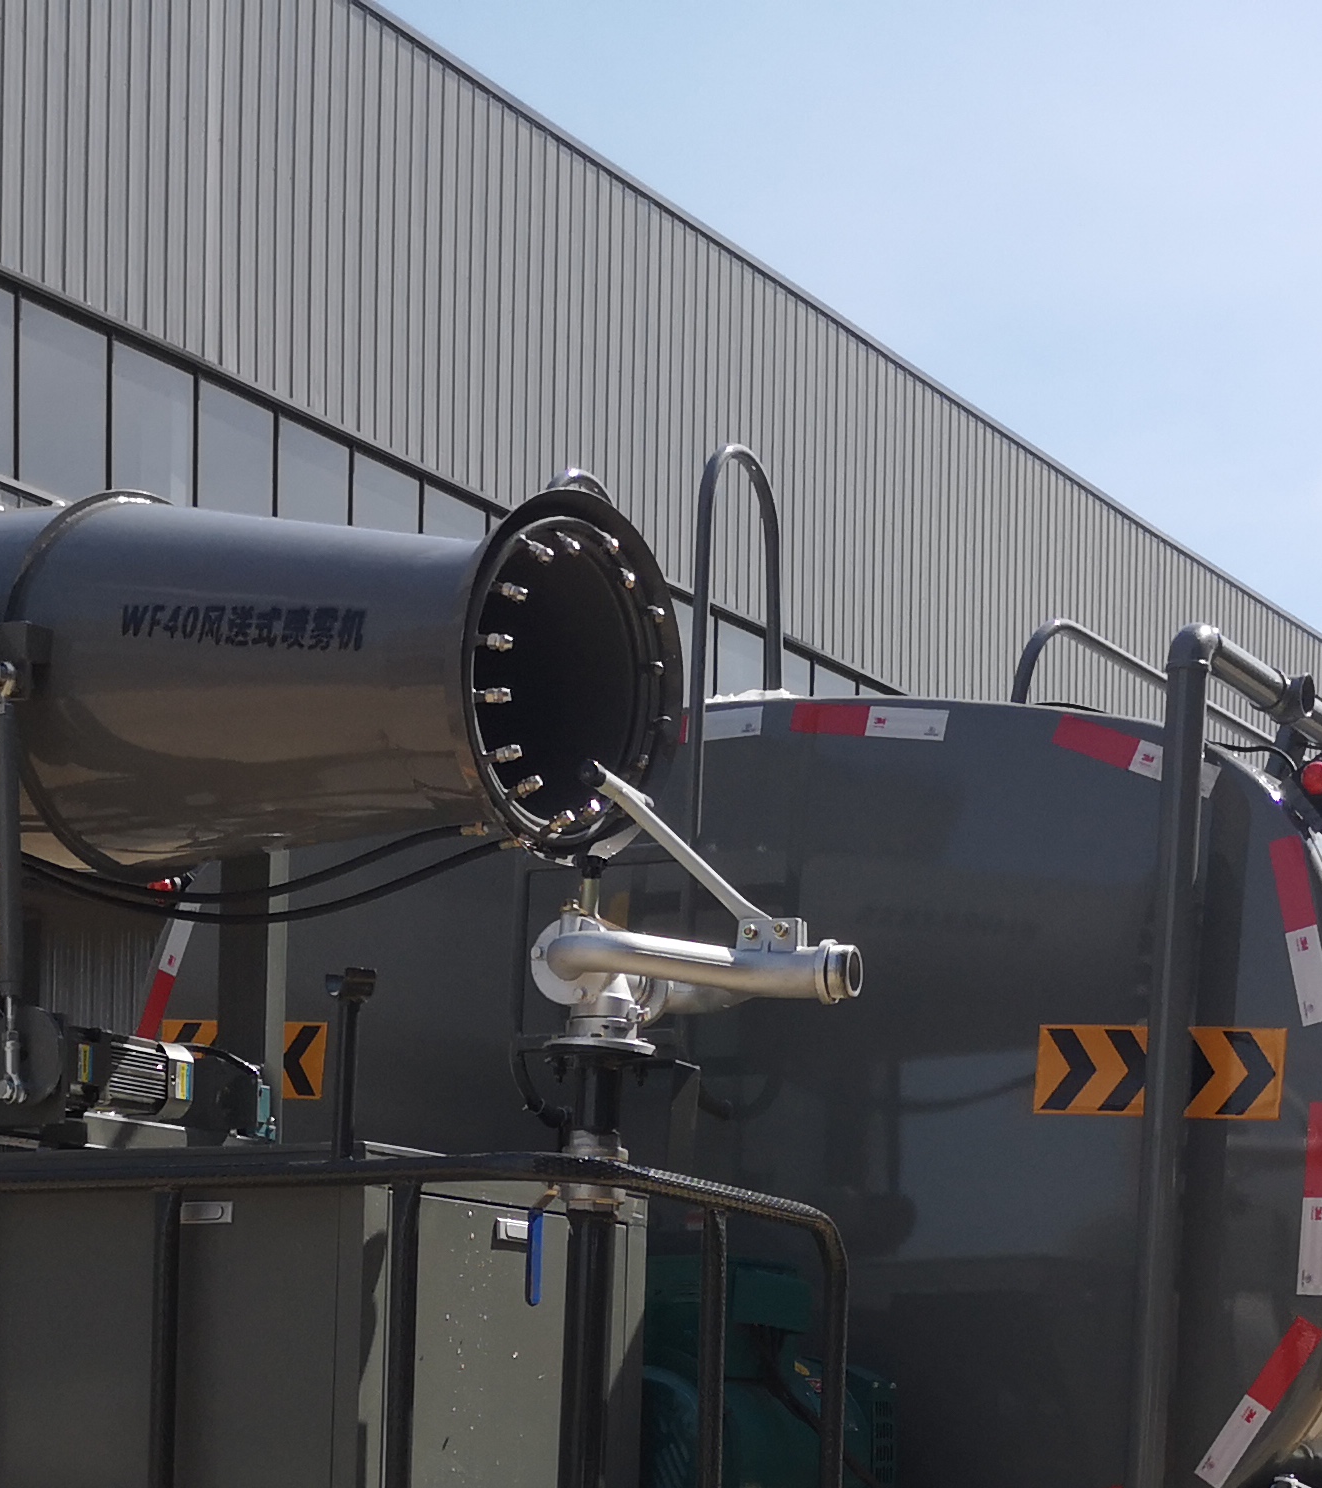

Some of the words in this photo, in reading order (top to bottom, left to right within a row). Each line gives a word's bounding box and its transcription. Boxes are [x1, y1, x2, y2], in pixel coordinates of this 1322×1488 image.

[121, 604, 367, 650] WF40风送式喷雾机
